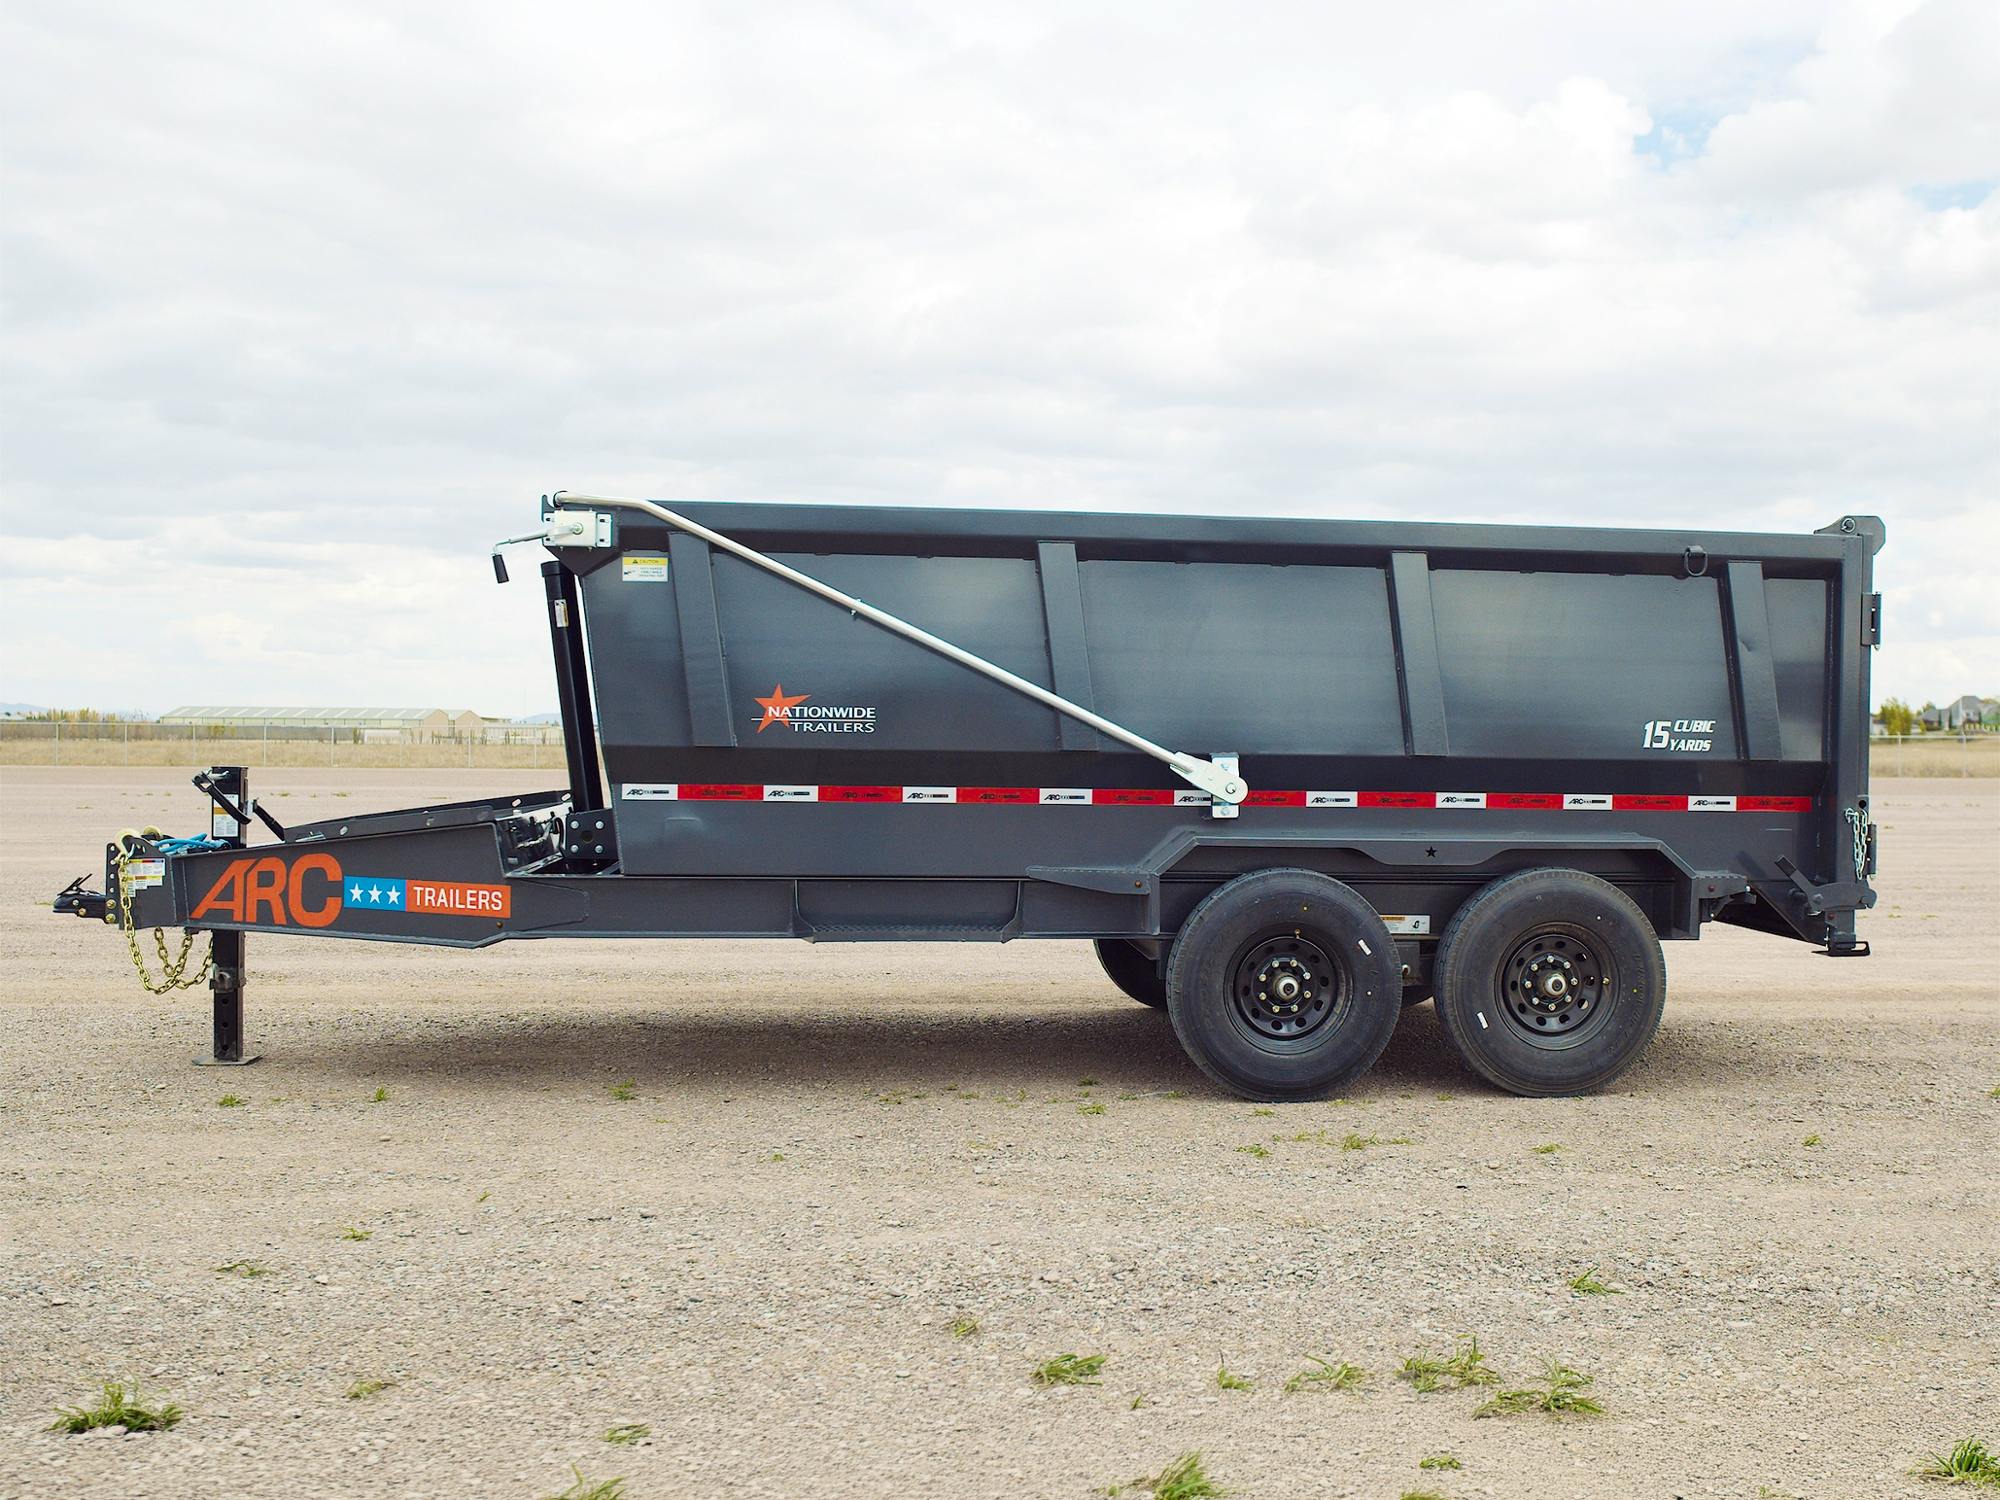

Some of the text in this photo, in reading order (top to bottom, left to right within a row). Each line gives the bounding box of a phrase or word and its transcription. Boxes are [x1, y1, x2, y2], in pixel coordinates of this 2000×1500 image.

[768, 706, 876, 718] NATIONWIDE
[790, 722, 875, 733] TRAILERS
[1673, 720, 1716, 732] CUBIC
[1643, 720, 1672, 748] 15
[1670, 740, 1712, 752] YARDS
[190, 853, 342, 928] ARC
[413, 885, 503, 911] TRAILERS
